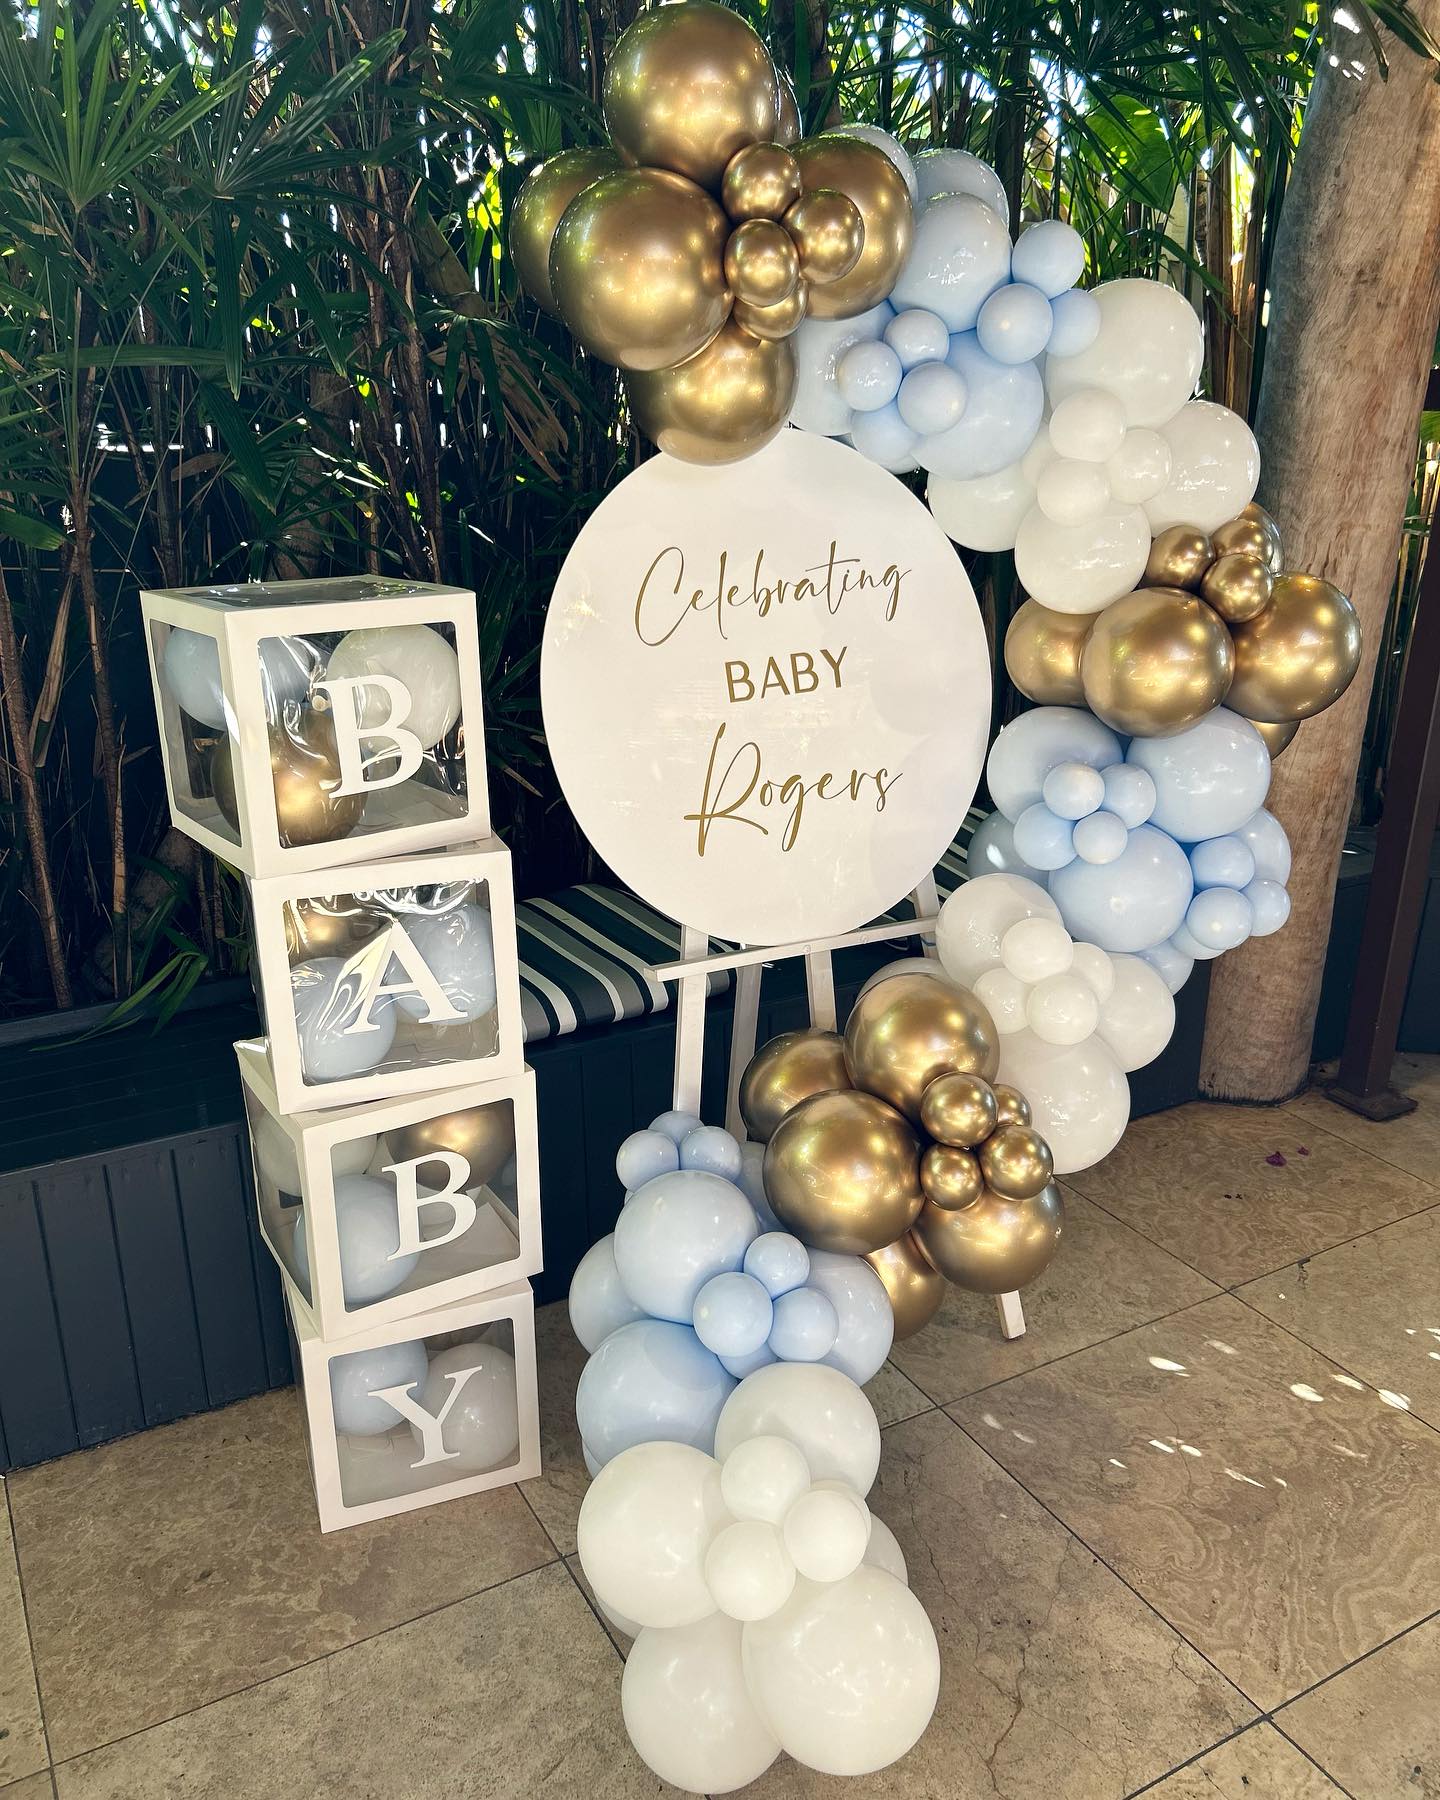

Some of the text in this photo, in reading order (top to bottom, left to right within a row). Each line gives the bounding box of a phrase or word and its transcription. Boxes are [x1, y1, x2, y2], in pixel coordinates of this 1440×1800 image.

[634, 540, 912, 647] Celebrating
[724, 646, 848, 703] BABY
[683, 722, 903, 858] Rogers
